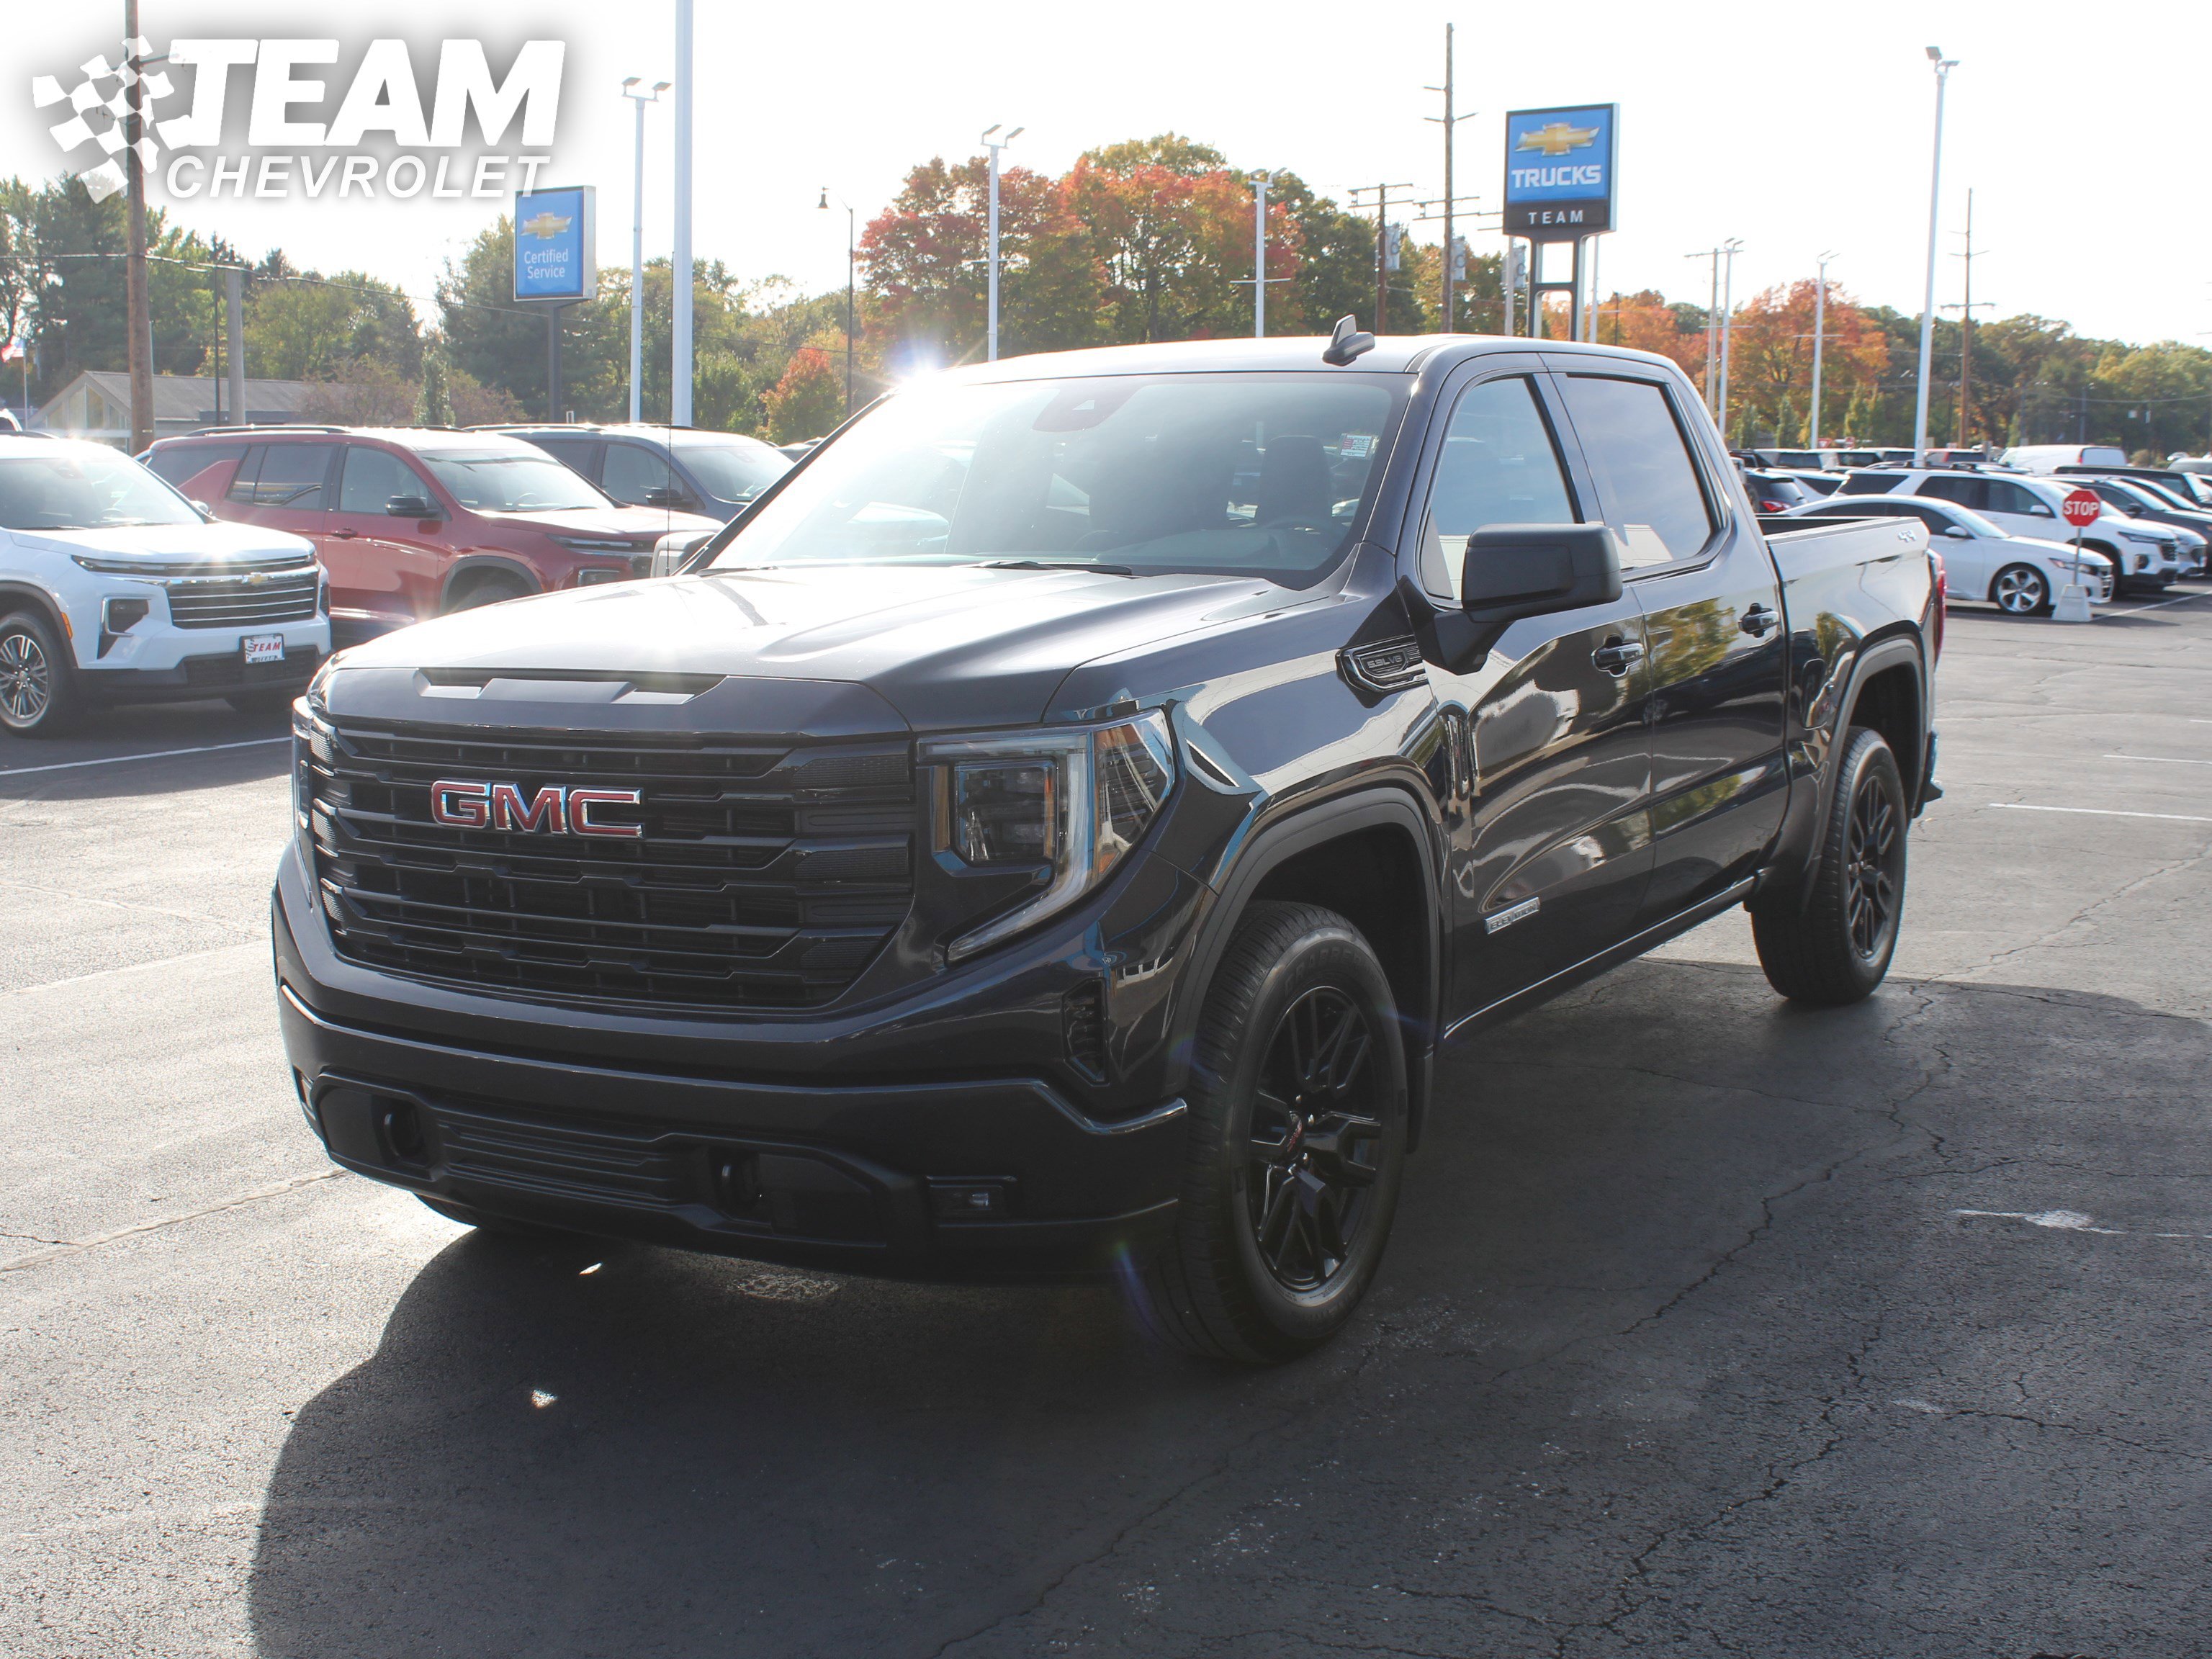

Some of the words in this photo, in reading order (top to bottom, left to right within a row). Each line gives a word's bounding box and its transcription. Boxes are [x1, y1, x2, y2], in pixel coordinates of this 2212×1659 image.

[1511, 165, 1601, 188] TRUCKS
[1529, 210, 1583, 225] TEAM
[524, 248, 569, 264] Certified
[527, 265, 565, 279] Service
[2063, 500, 2099, 516] STOP
[253, 642, 281, 652] TEAM
[432, 779, 643, 840] GMC
